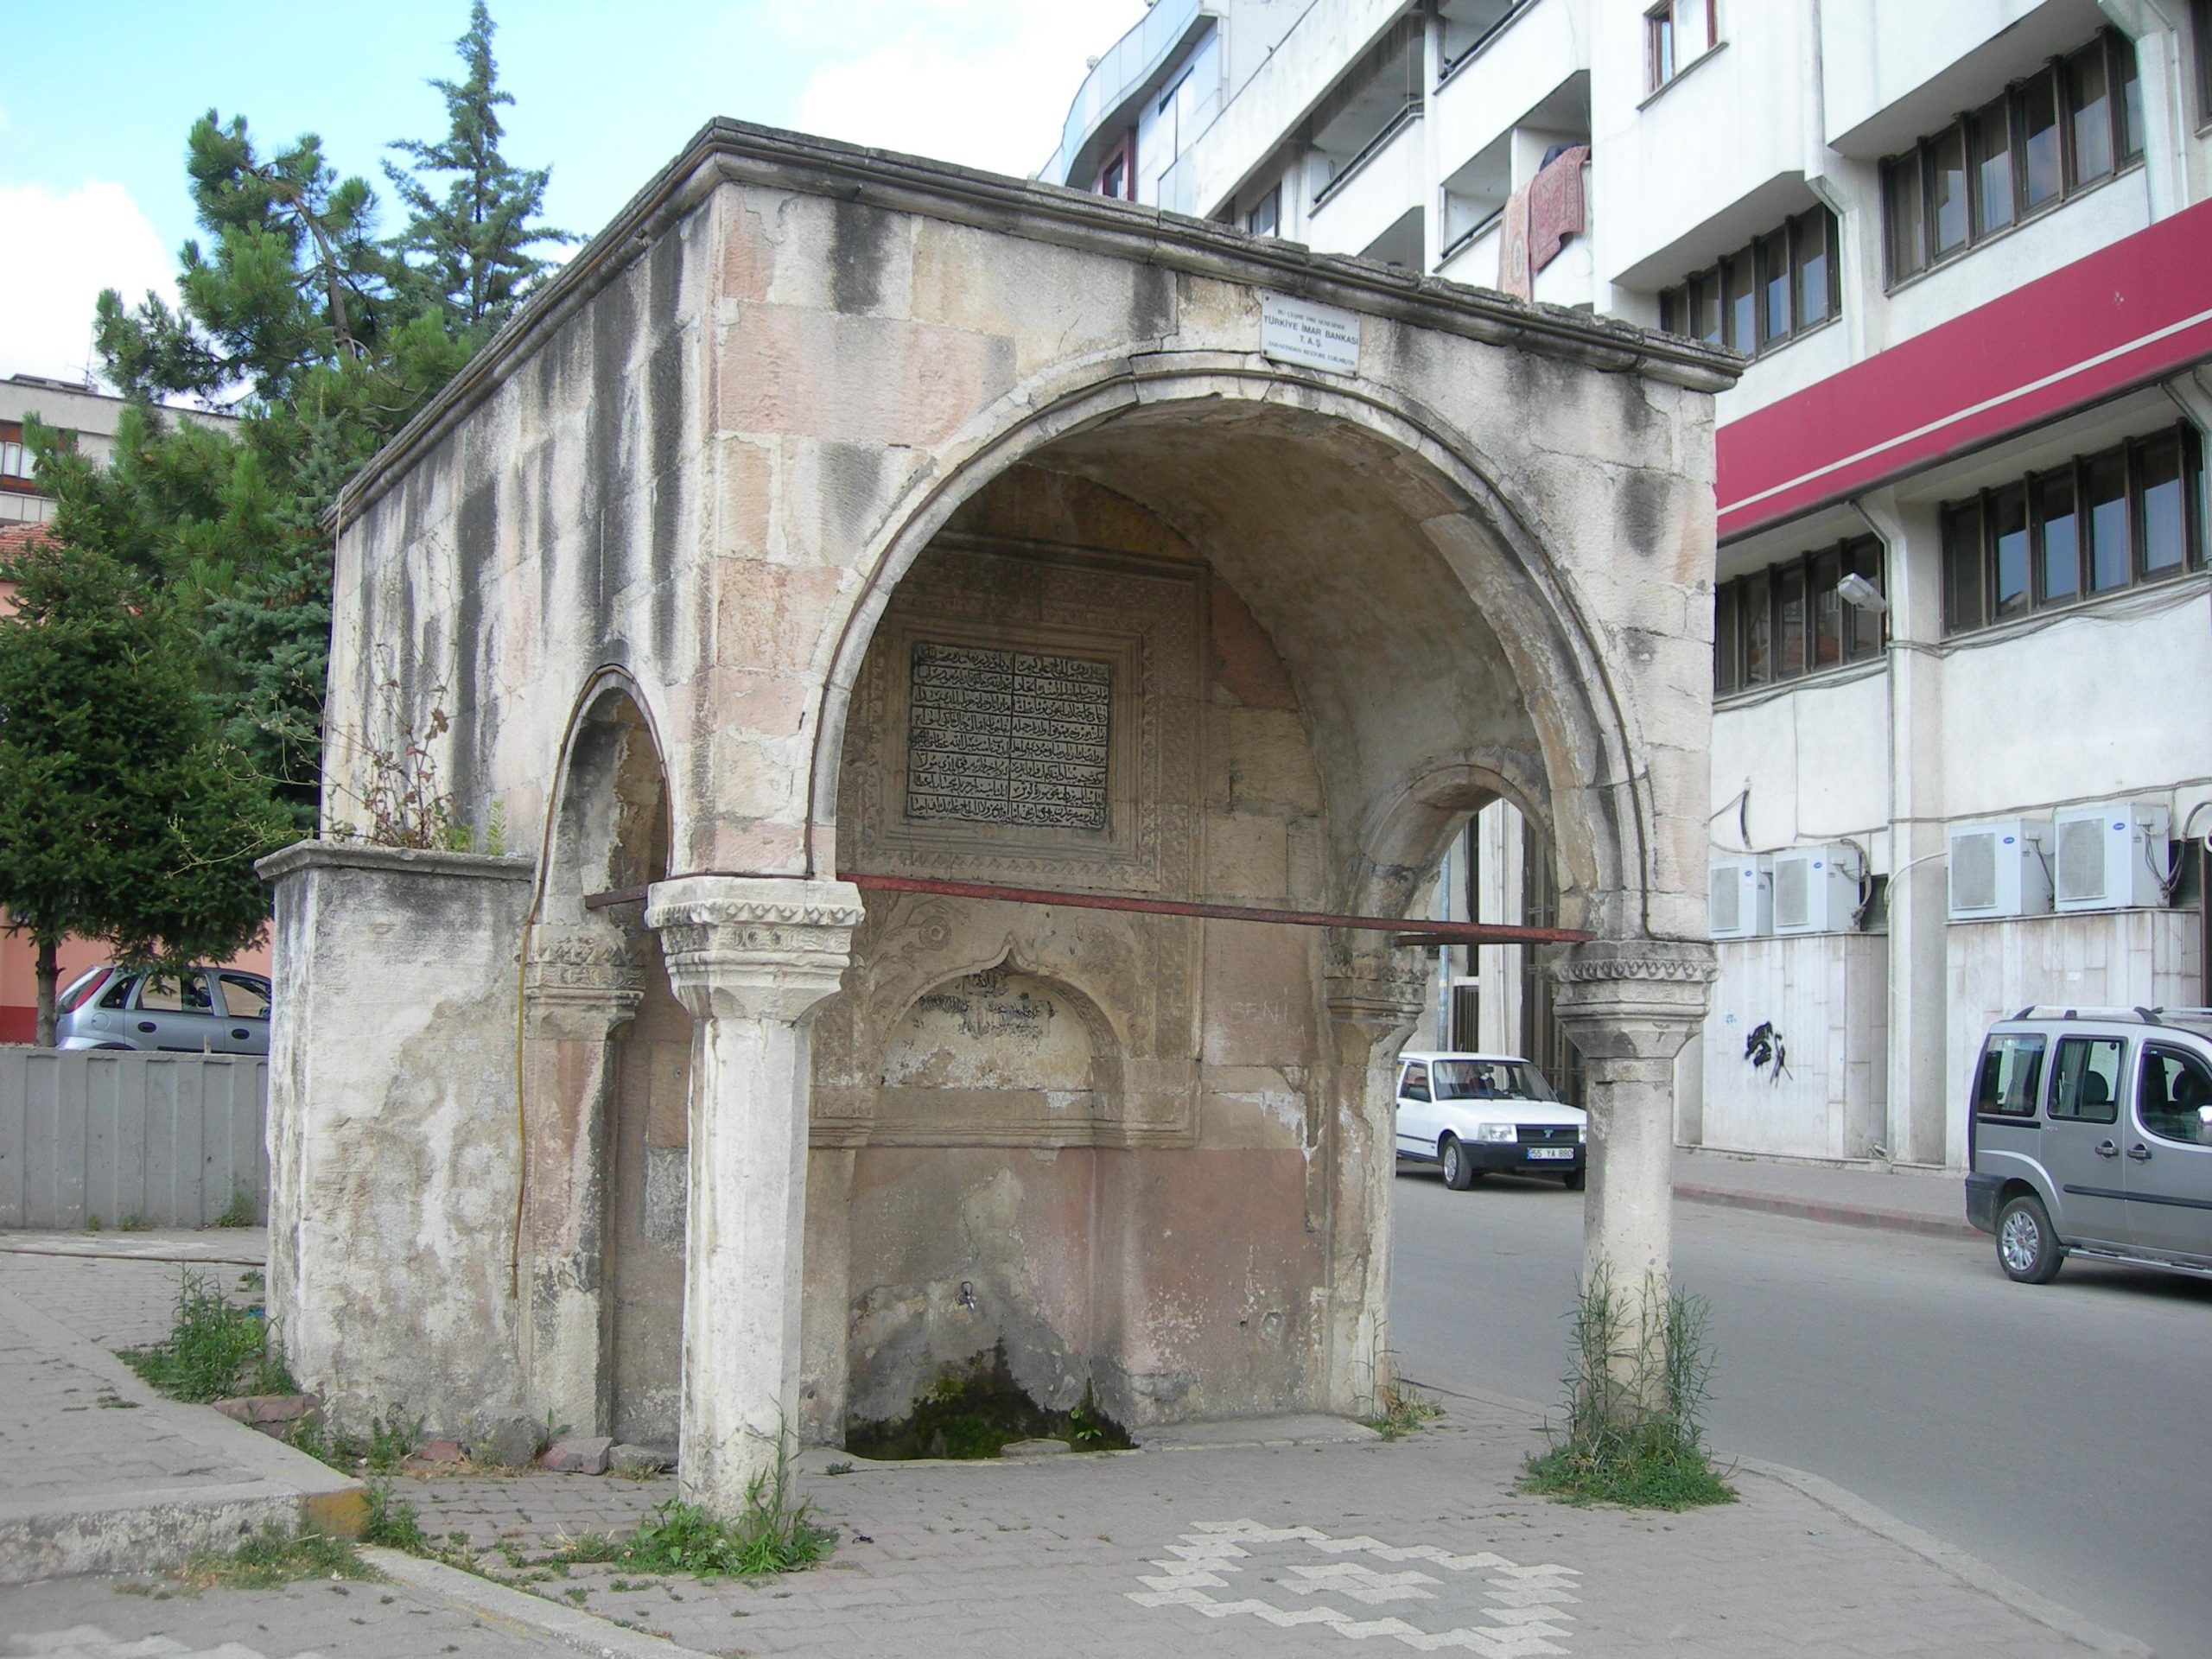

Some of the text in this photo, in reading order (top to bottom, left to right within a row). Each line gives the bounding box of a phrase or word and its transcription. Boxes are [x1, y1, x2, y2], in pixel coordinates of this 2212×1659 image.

[1263, 314, 1358, 346] TÜRKİYE İMAR BANKASI
[1532, 1149, 1573, 1158] 55 YA 880
